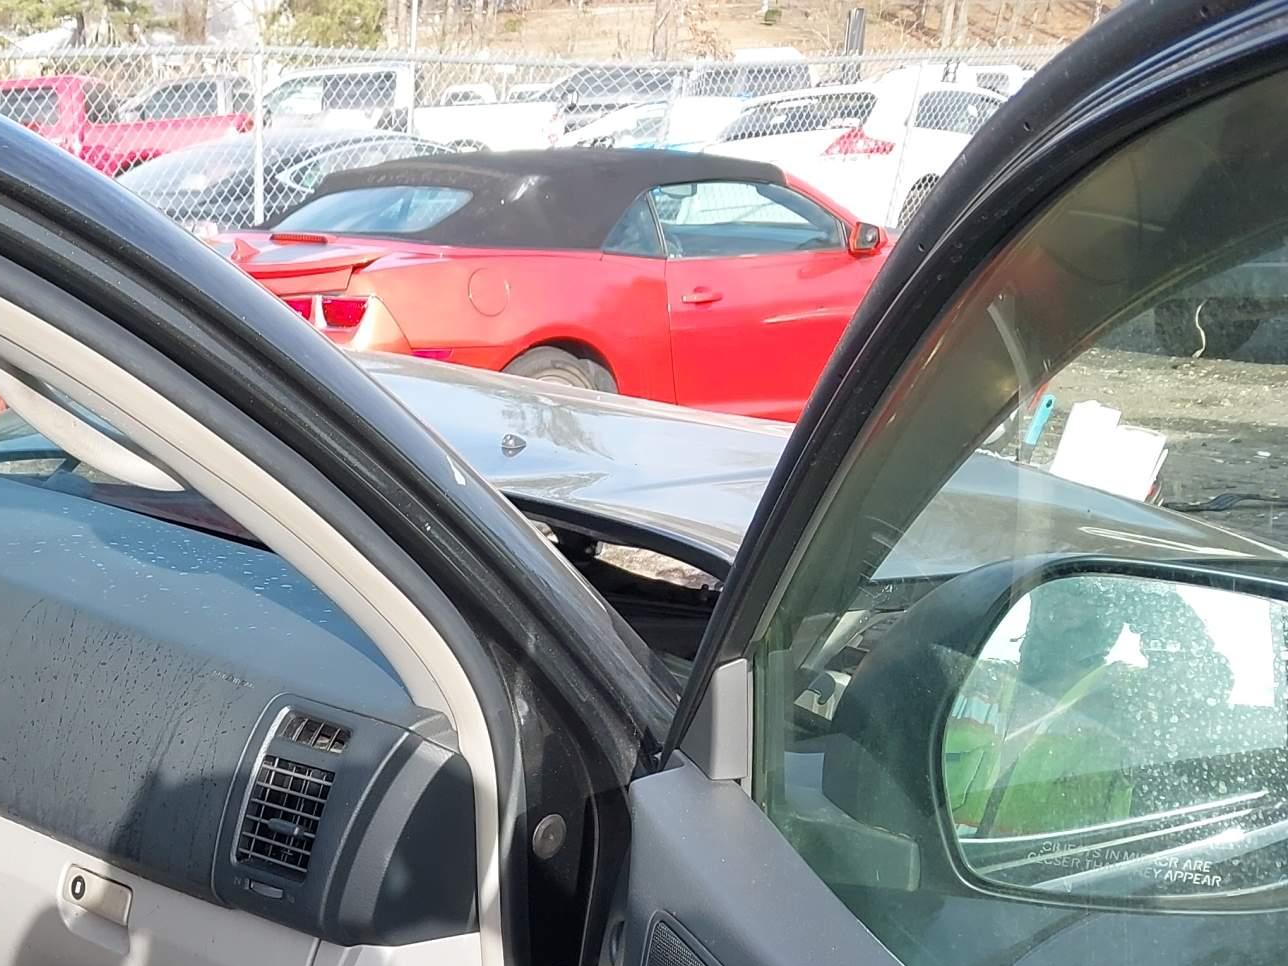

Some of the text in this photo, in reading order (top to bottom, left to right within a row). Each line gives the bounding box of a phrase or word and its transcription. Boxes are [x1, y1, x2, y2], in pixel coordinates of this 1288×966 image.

[1041, 841, 1213, 872] OBJETS IN MIROR ARE
[1164, 870, 1222, 887] APPEAR
